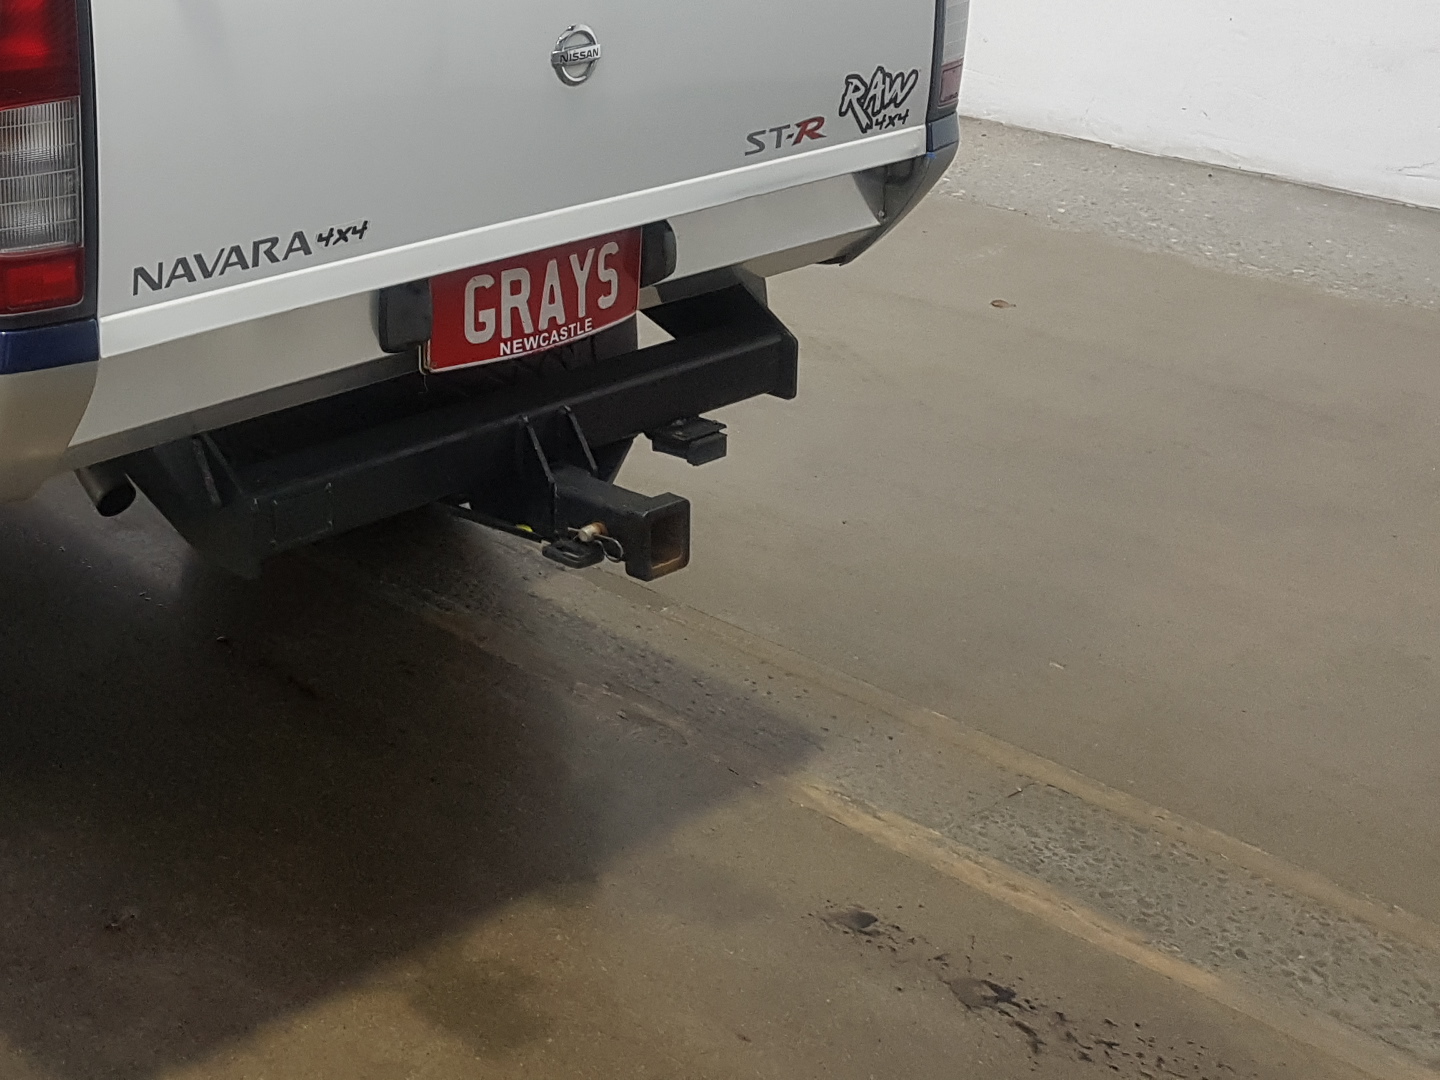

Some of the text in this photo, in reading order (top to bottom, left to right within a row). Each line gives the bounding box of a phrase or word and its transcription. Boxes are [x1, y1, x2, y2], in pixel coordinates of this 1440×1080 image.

[560, 47, 599, 63] NISSAN
[838, 65, 919, 134] RAW
[744, 116, 827, 156] ST-R
[132, 230, 312, 296] NAVARA
[464, 241, 620, 344] GRAYS
[499, 317, 593, 356] NEWCASTLE
